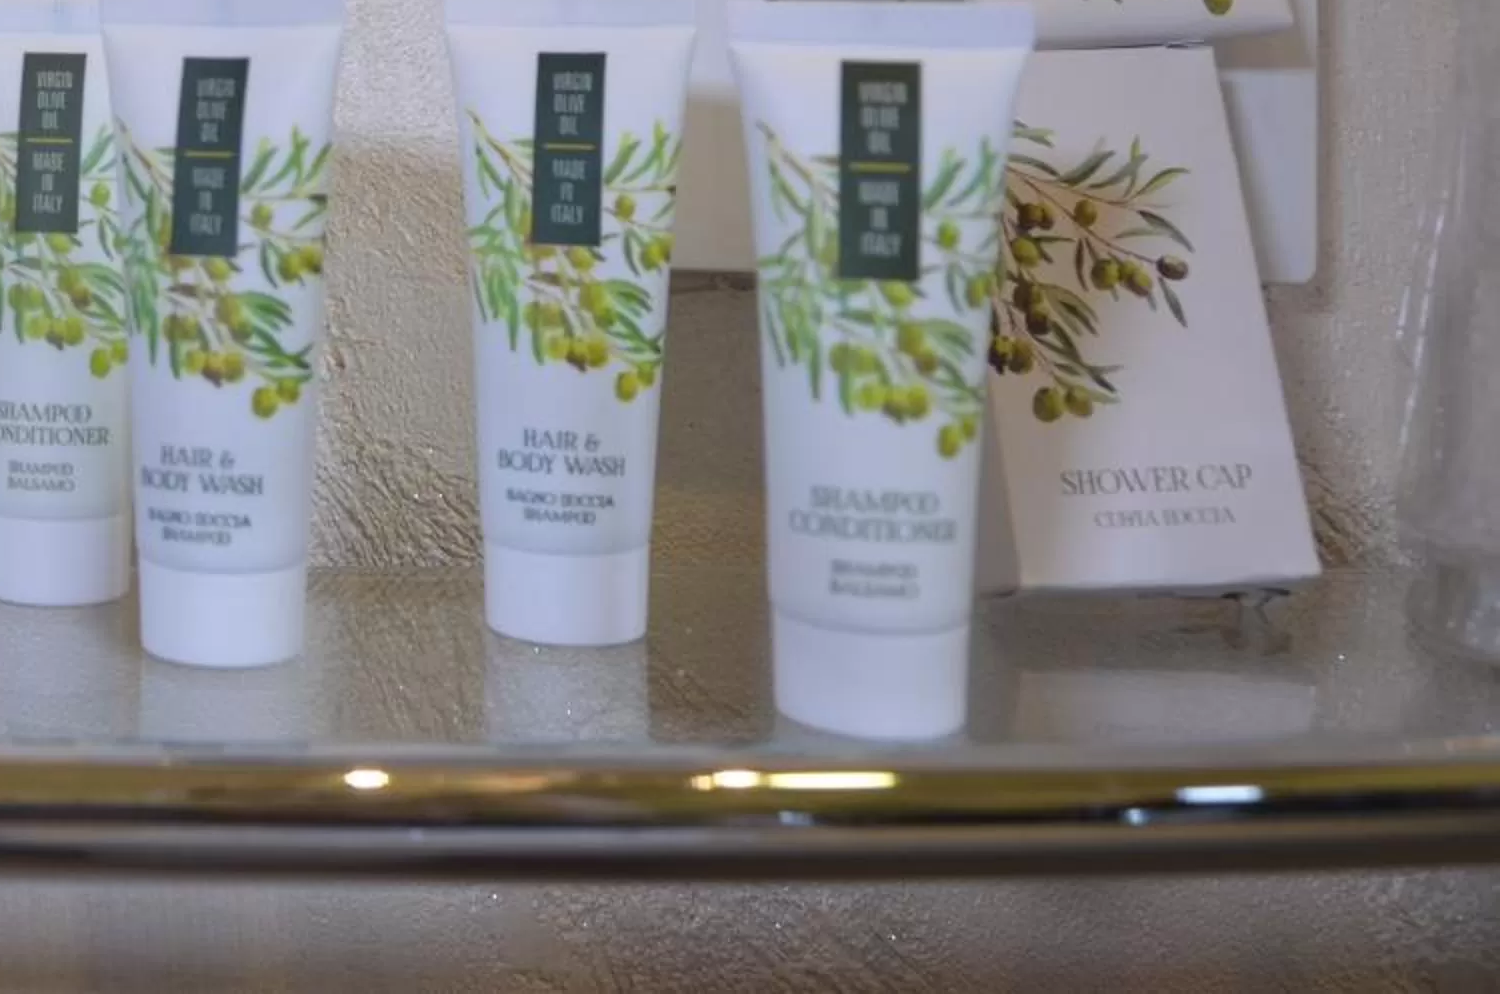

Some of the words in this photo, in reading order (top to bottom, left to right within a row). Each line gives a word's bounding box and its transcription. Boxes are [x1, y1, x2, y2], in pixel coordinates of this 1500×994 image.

[36, 90, 66, 110] OLIVE
[553, 93, 586, 113] OLIVE
[41, 110, 59, 130] OIL
[559, 115, 579, 135] OIL
[32, 153, 64, 171] MADE
[552, 159, 586, 180] MADE
[32, 194, 63, 214] ITALY
[189, 213, 223, 236] ITALY
[551, 205, 583, 224] ITALY
[523, 427, 579, 451] HAIR
[584, 433, 600, 452] &
[160, 445, 213, 467] HAIR
[219, 449, 236, 468] &
[497, 448, 556, 475] BODY
[563, 455, 627, 478] WASH
[141, 464, 191, 493] BODY
[198, 473, 263, 496] WASH
[1060, 465, 1191, 496] SHOWER
[1196, 462, 1253, 492] CAP
